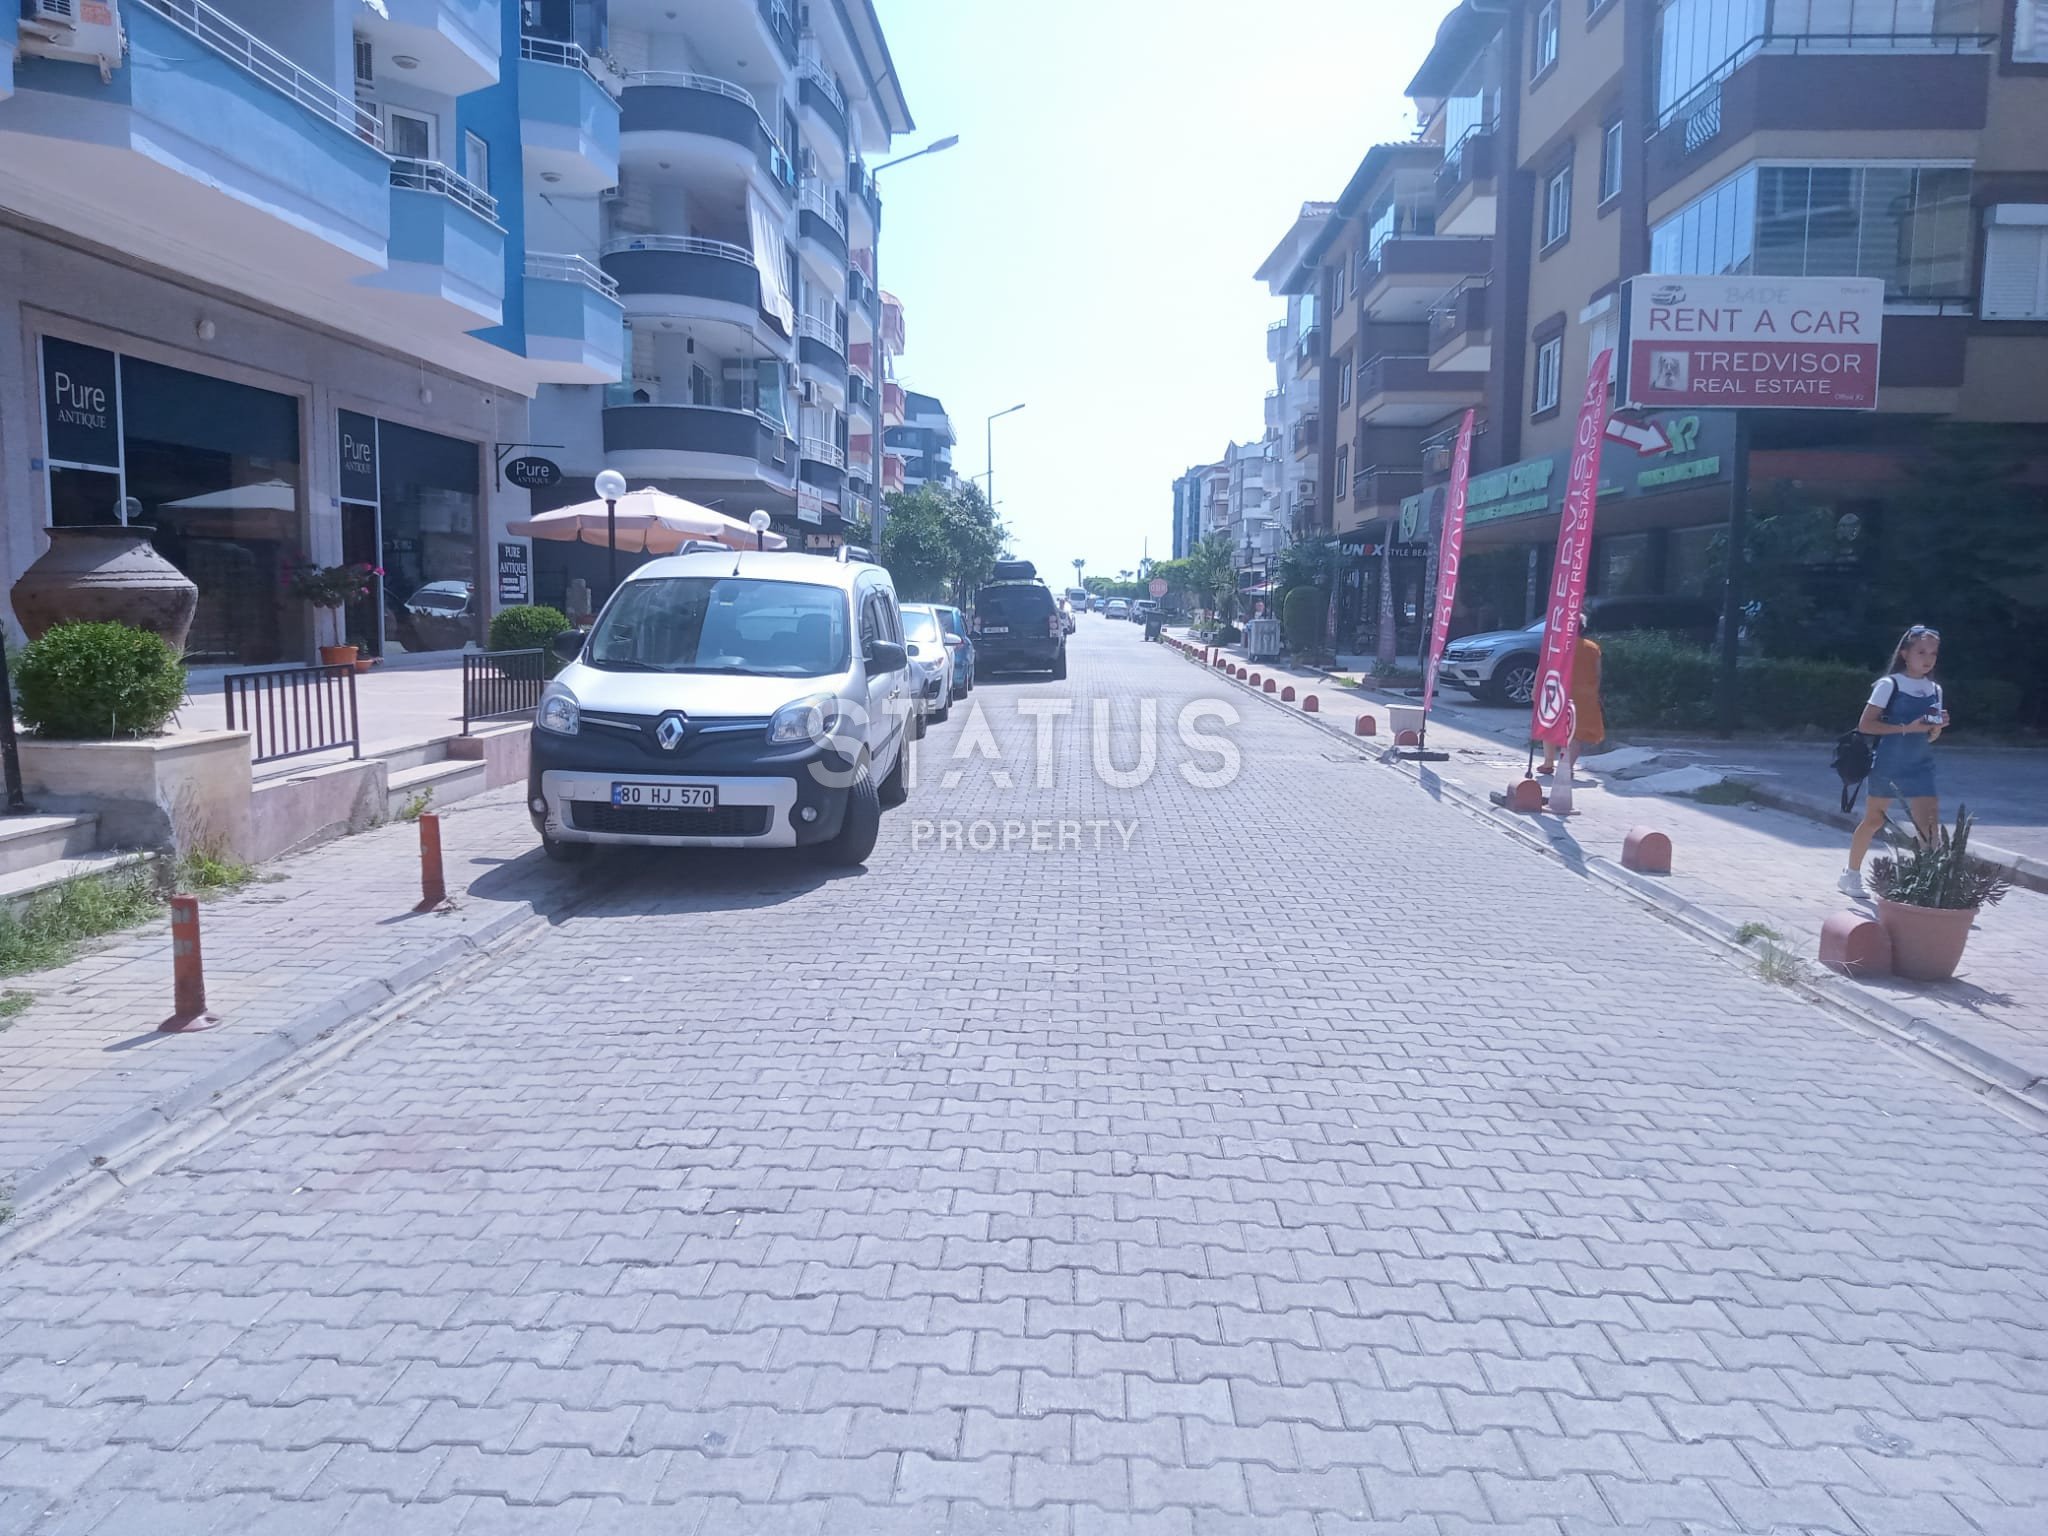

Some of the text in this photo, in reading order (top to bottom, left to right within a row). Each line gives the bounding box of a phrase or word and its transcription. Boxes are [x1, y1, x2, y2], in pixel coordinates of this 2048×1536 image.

[1649, 308, 1861, 334] RENT A CAR
[1694, 352, 1861, 373] TREDVISOR
[55, 372, 105, 412] Pure
[1693, 379, 1831, 394] REAL ESTATE
[58, 409, 106, 429] ANTIQUE
[344, 434, 371, 461] Pure
[516, 461, 549, 477] Pure
[1577, 468, 1593, 530] ESTATE
[505, 546, 520, 557] PURE
[1571, 538, 1585, 582] REAL
[621, 787, 640, 802] 80
[651, 788, 671, 803] HJ
[681, 789, 711, 805] 570
